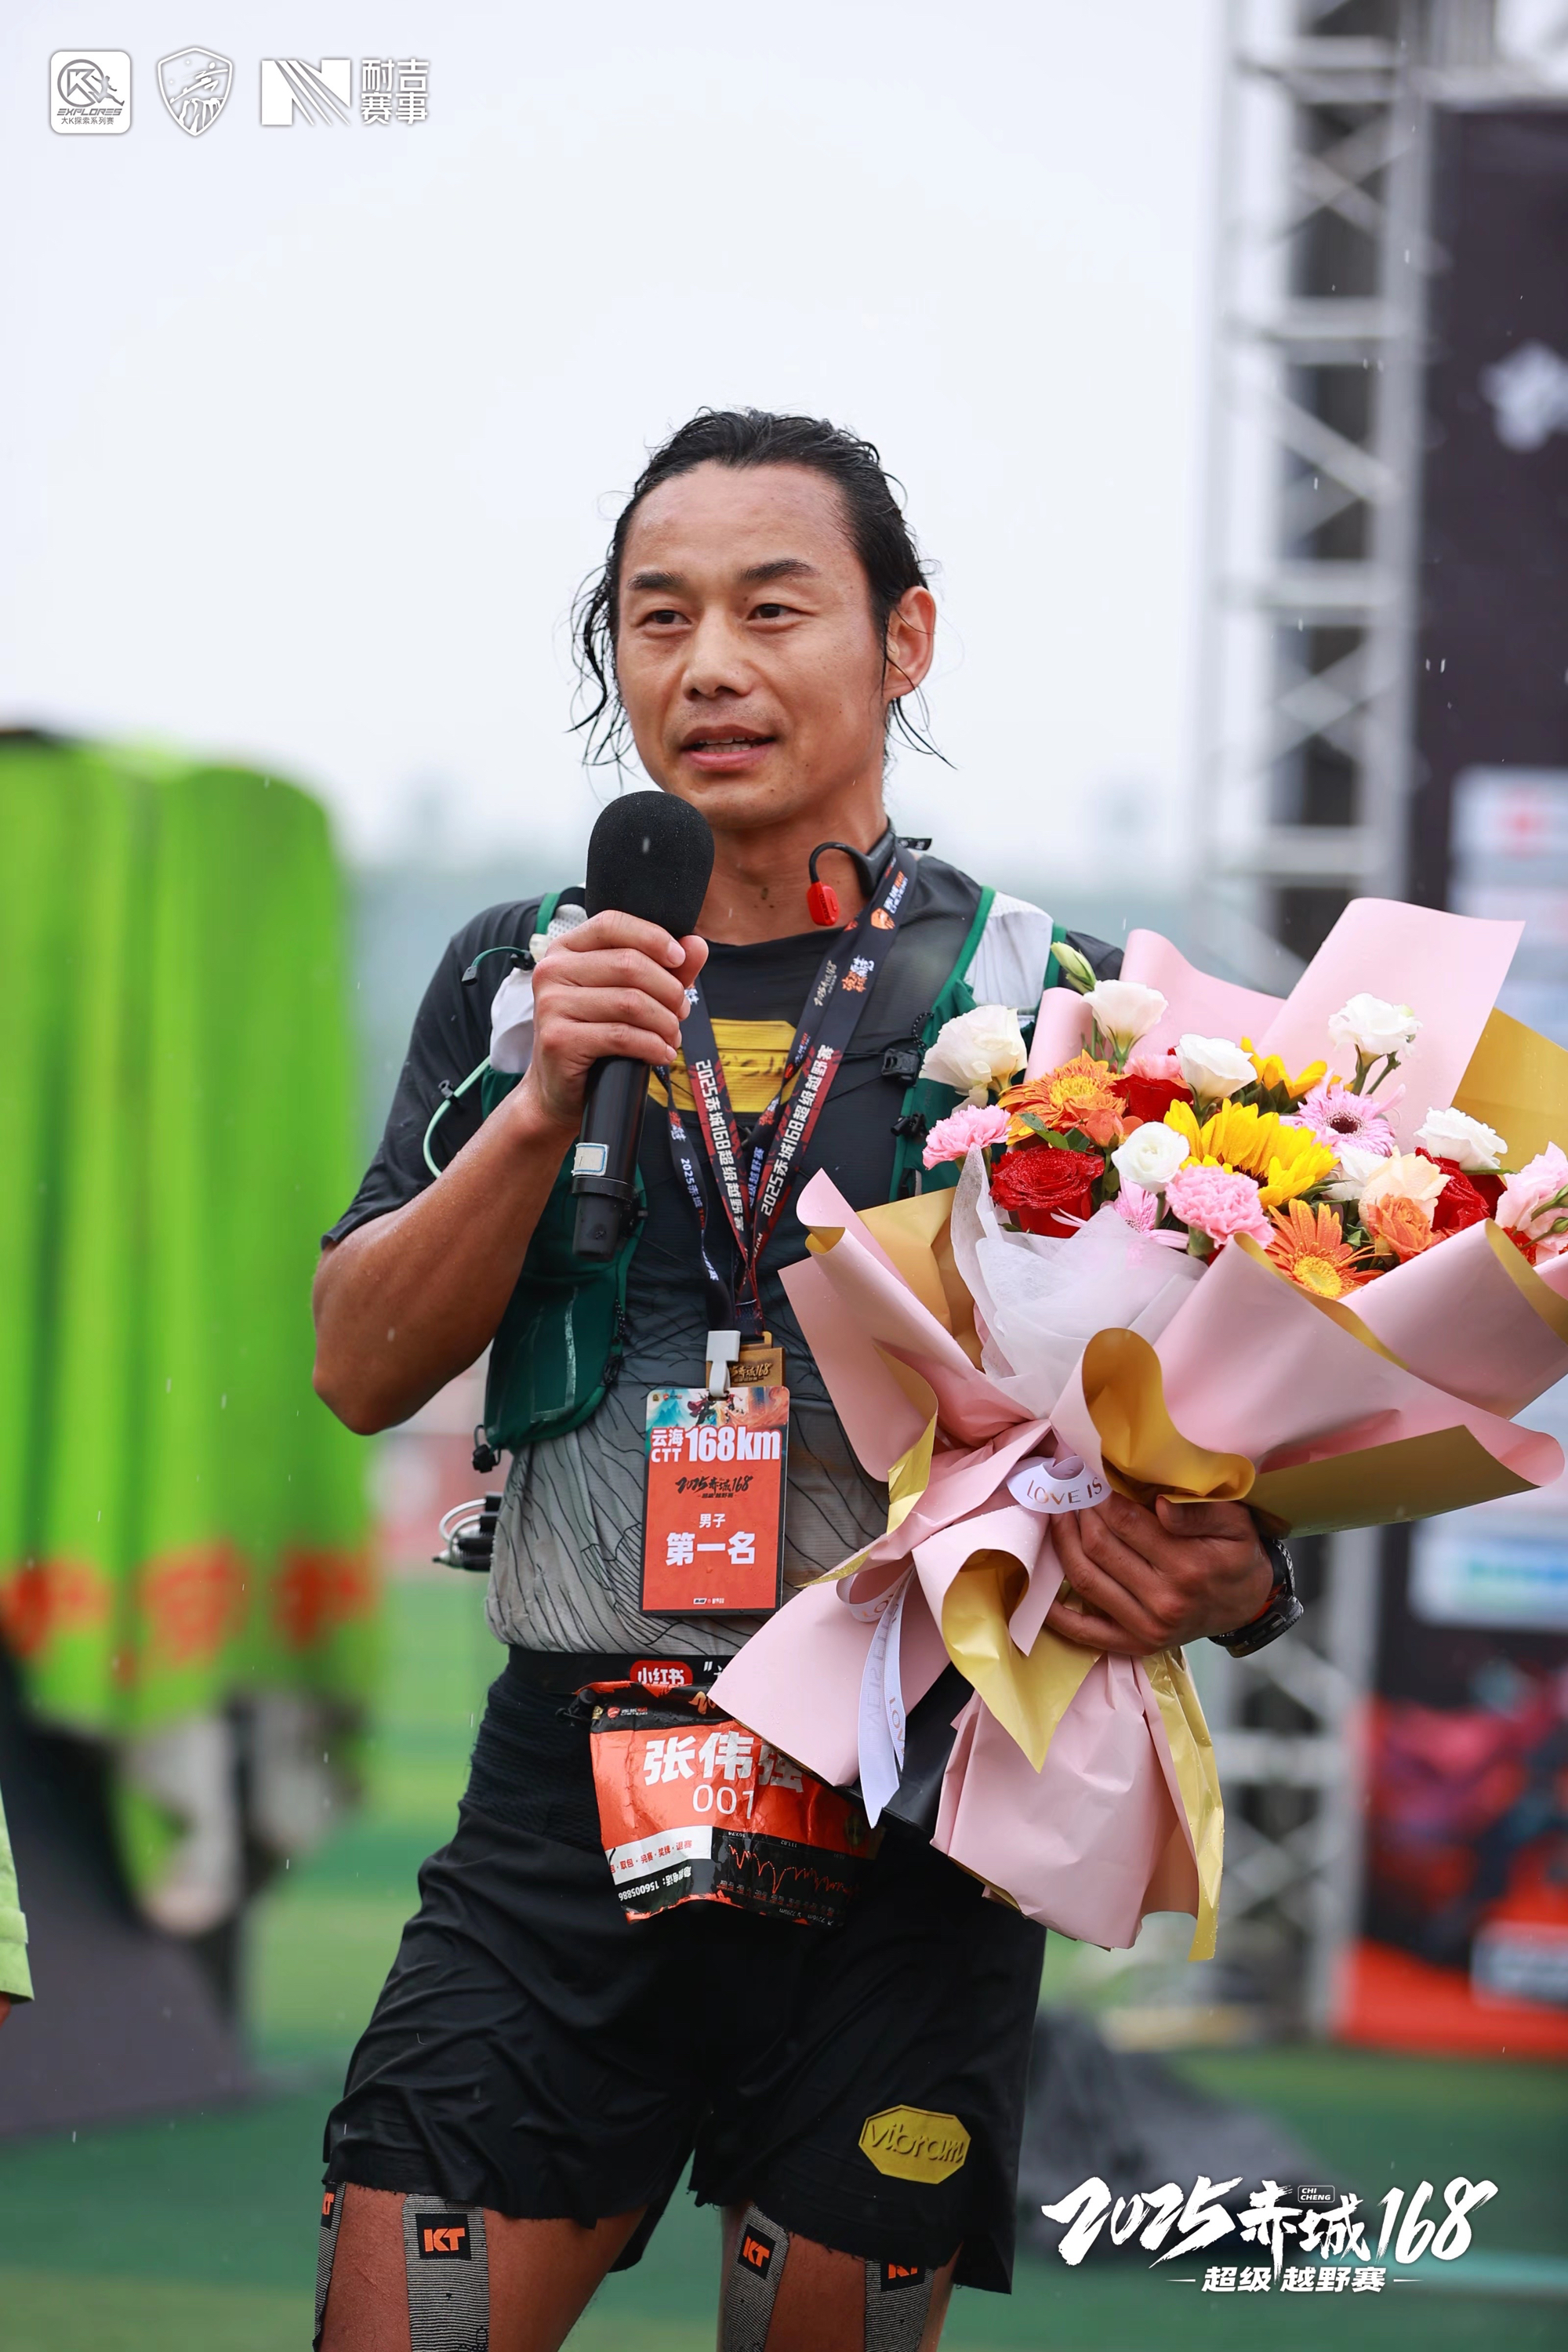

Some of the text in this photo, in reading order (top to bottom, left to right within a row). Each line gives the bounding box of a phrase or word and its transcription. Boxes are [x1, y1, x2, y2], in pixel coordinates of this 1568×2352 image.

[695, 1058, 745, 1232] 2025赤城168超级越野赛
[761, 1044, 835, 1217] 2025赤城168超级越野赛
[651, 1448, 682, 1463] CTT
[652, 1426, 781, 1462] 云海 168km
[1026, 1476, 1103, 1505] LOVE IS
[699, 1513, 726, 1528] 男子
[666, 1531, 756, 1566] 第一名
[637, 1668, 685, 1685] 小红书
[889, 1697, 906, 1755] LOV
[692, 1784, 755, 1820] 001
[423, 2227, 465, 2252] KT
[742, 2235, 770, 2267] KT
